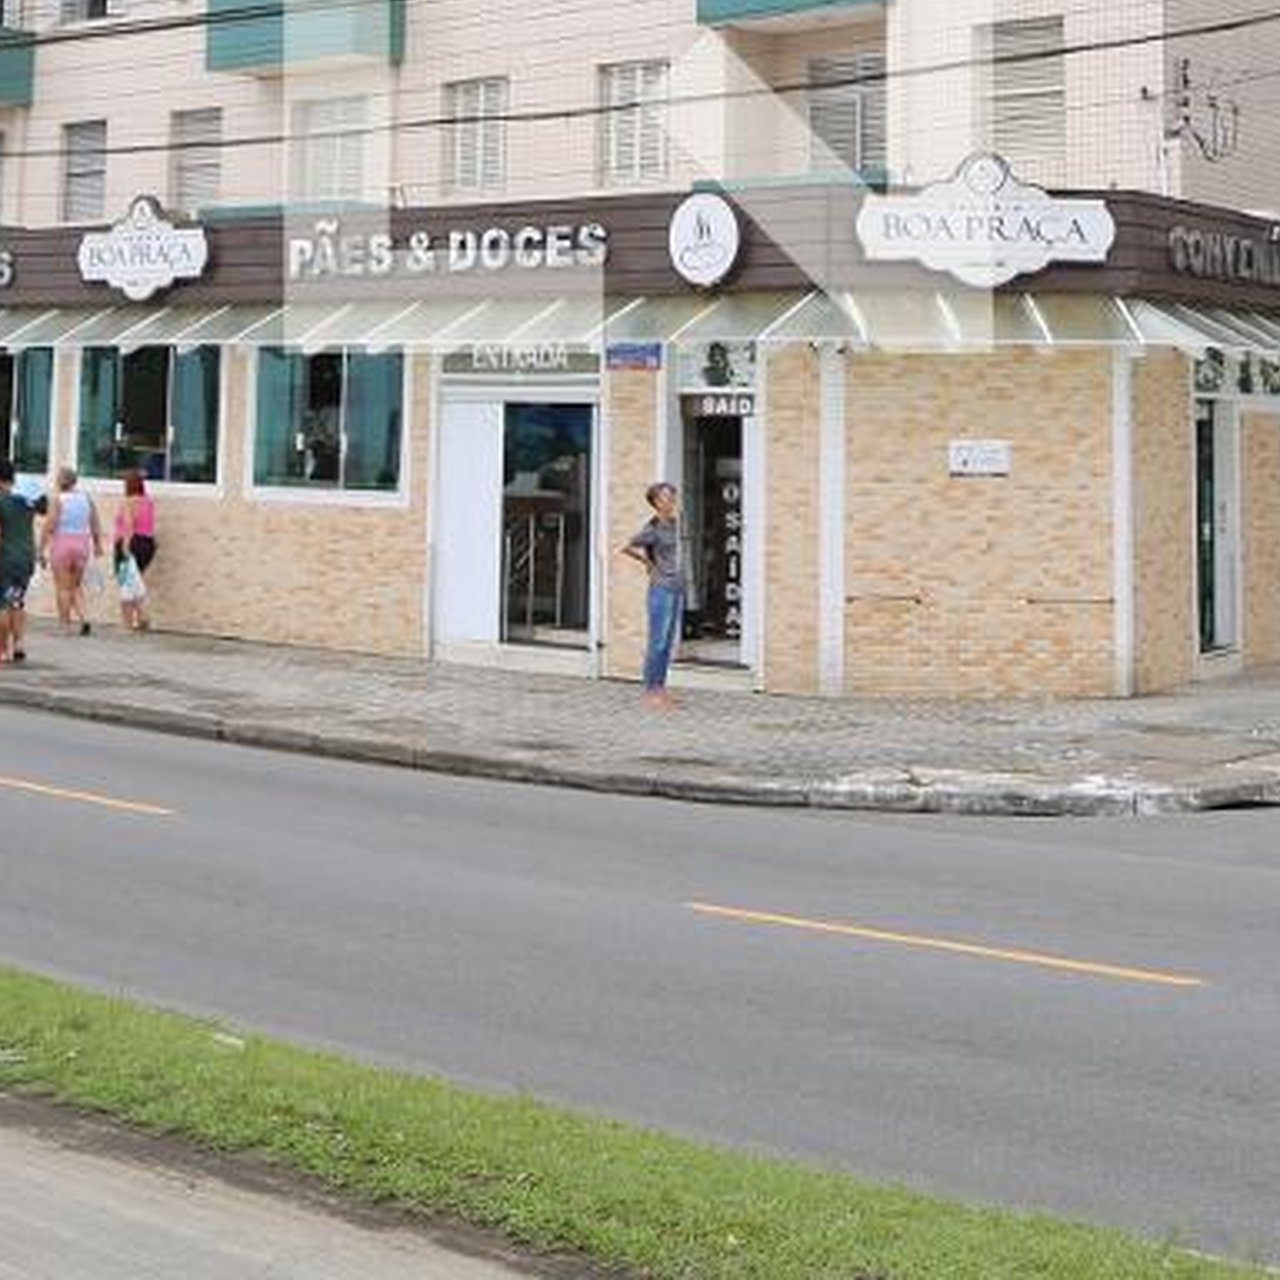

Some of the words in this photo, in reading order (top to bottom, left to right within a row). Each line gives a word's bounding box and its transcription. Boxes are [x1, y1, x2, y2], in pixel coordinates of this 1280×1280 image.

[288, 219, 392, 278] PÃES
[407, 231, 435, 272] &
[448, 222, 608, 271] DOCES
[882, 212, 957, 241] BOA
[964, 214, 1089, 246] PRAÇA
